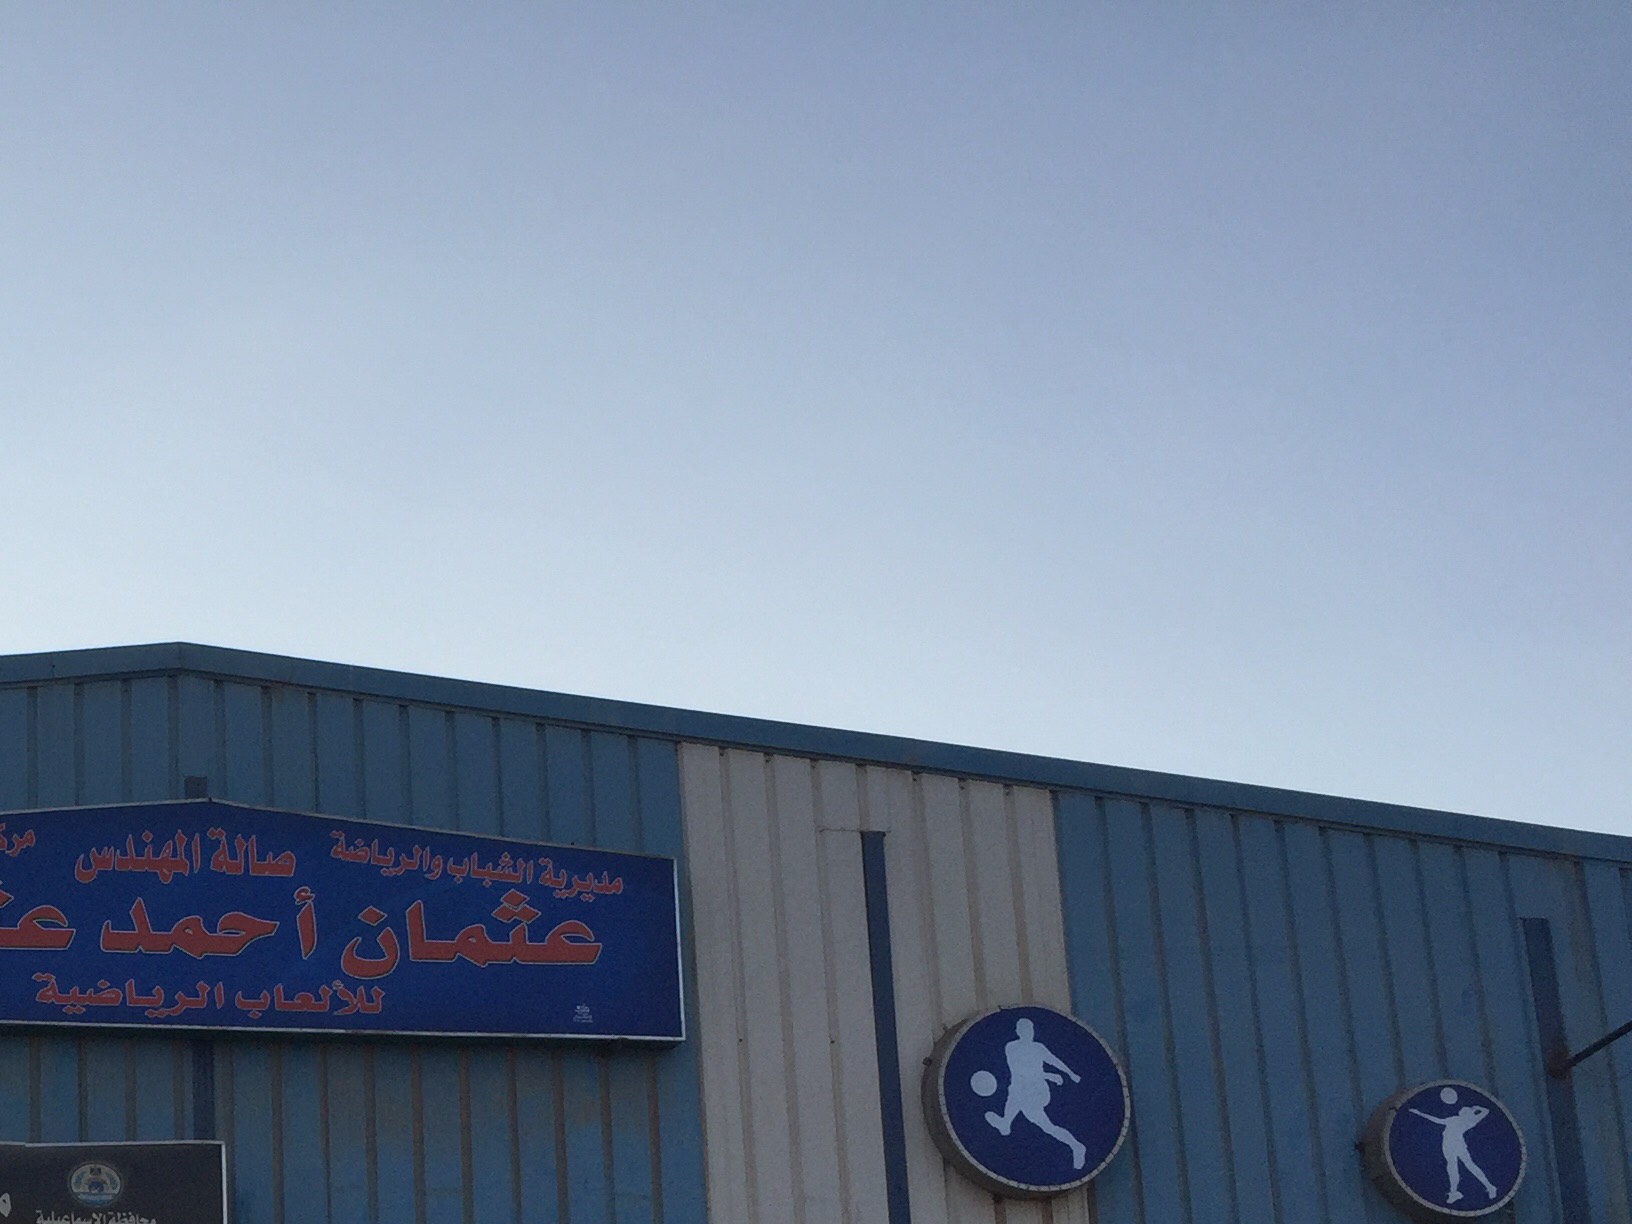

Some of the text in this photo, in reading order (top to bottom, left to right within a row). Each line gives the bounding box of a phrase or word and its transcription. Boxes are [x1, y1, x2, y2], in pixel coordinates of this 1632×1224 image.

[74, 827, 297, 884] صالة المهندس
[329, 830, 624, 902] مديرية الشباب والرياضة
[100, 886, 316, 960] أحمد
[340, 888, 603, 980] عثمان
[31, 972, 386, 1018] للألعاب الرياضية
